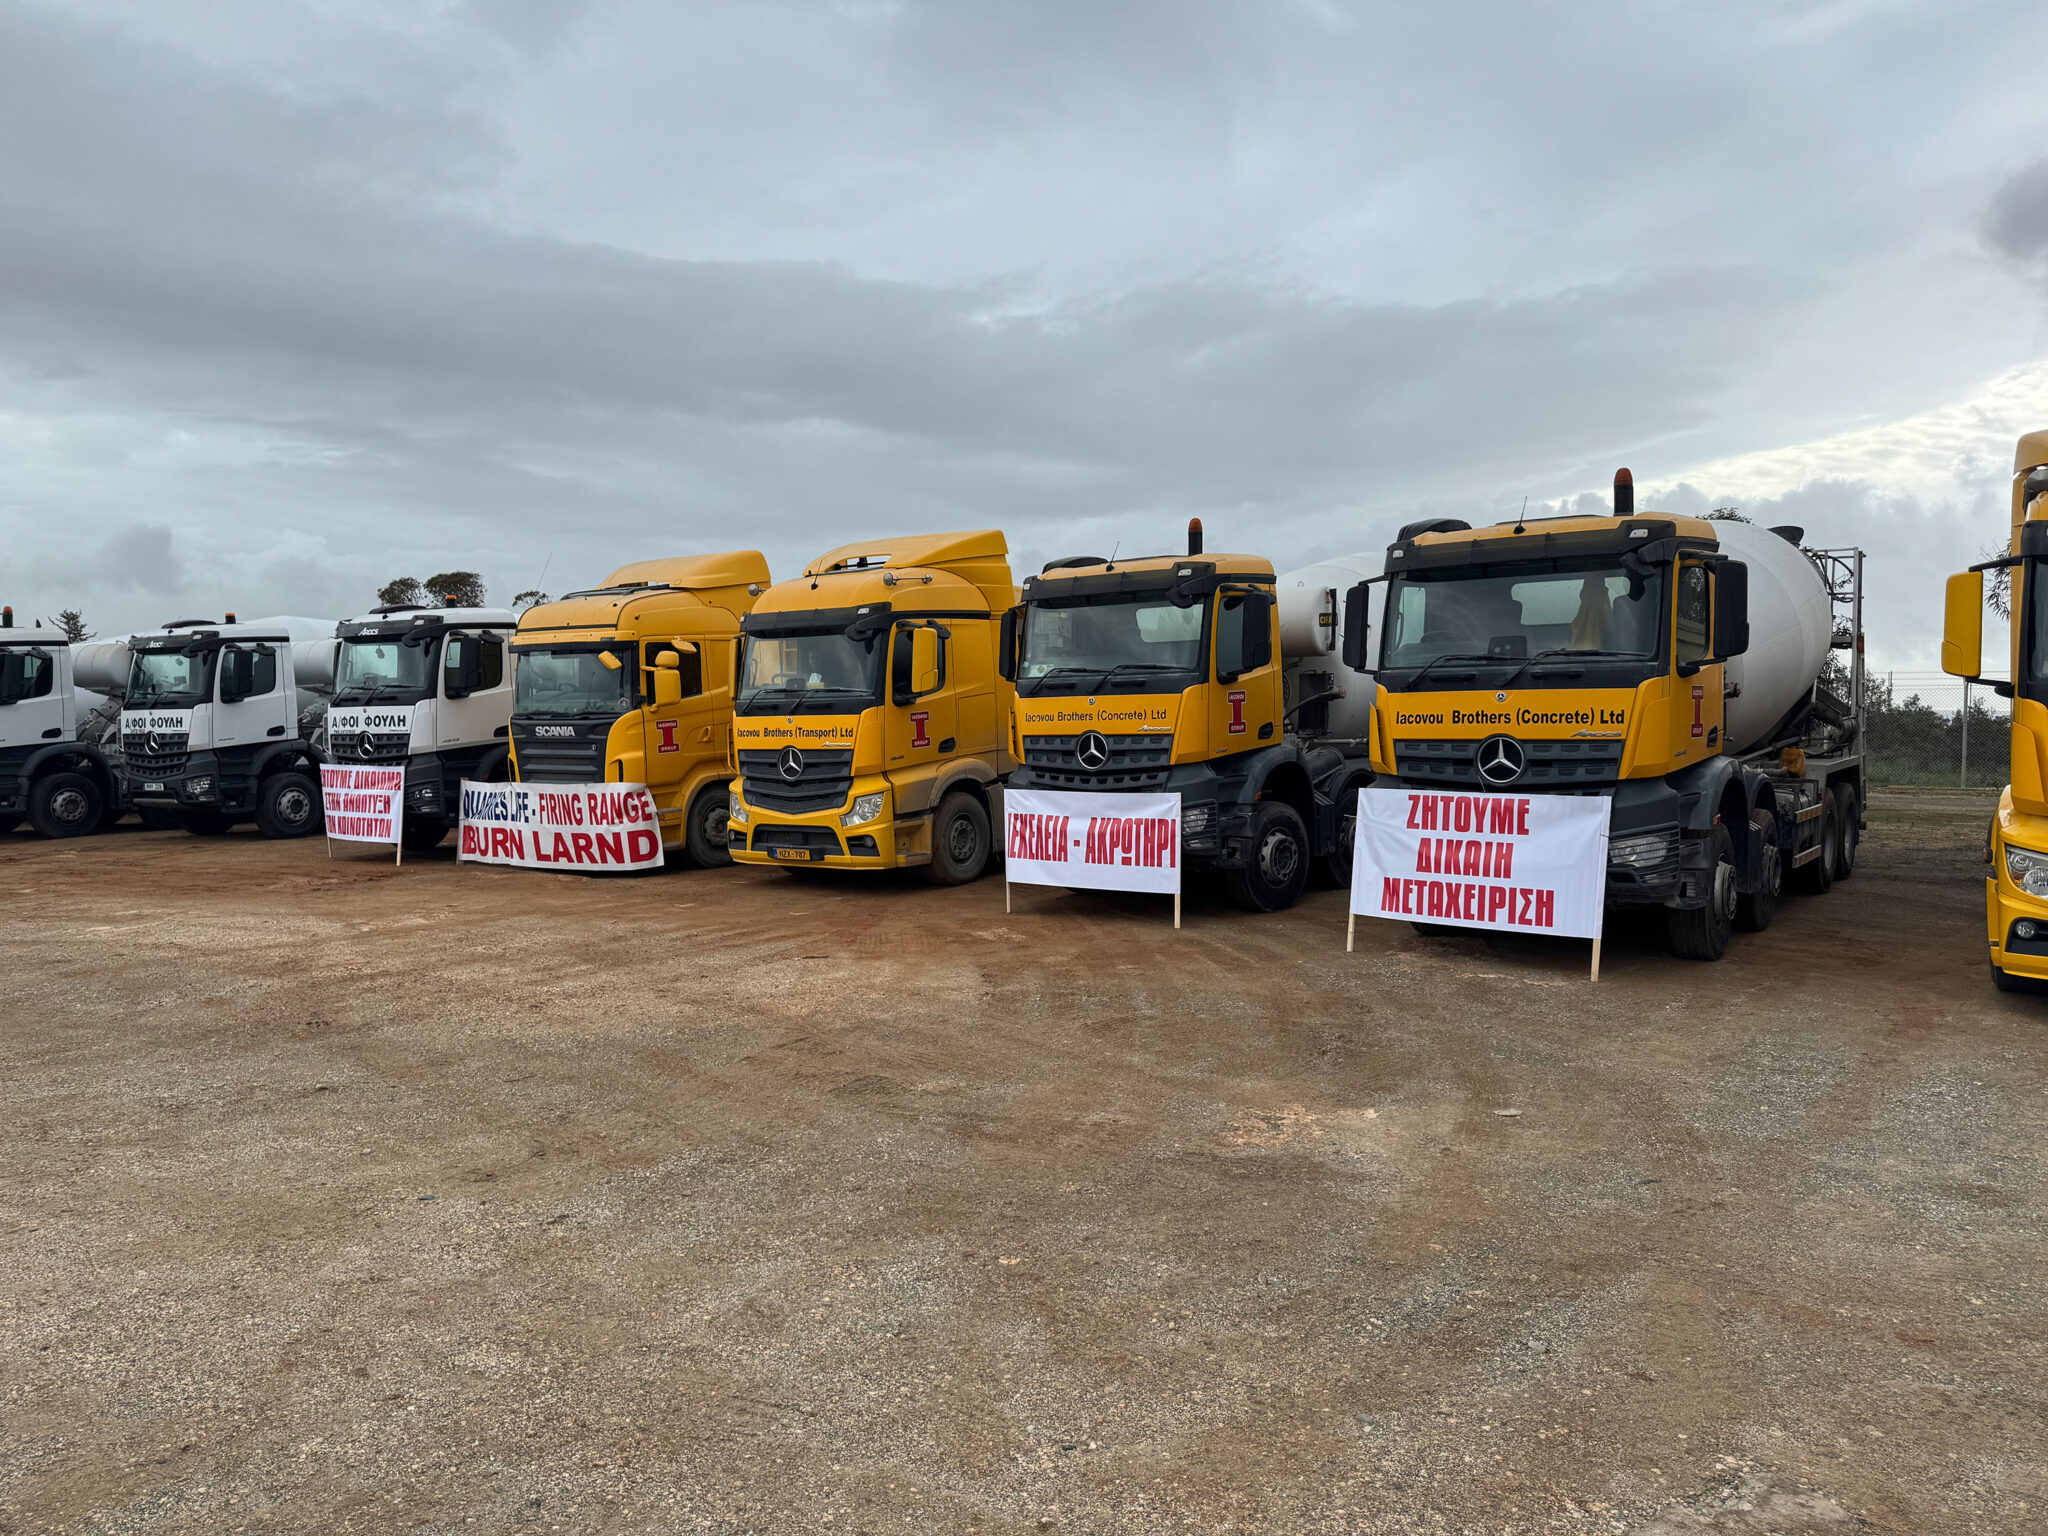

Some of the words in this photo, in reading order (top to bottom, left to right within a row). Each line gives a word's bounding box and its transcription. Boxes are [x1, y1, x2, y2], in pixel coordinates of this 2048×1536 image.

[149, 716, 183, 729] ΦΟΥΛΗ
[364, 713, 407, 728] ΦΟΥΛΗ
[1025, 712, 1055, 723] Iacovou
[1057, 711, 1094, 722] Brothers
[1097, 709, 1147, 722] (Concrete)
[1151, 709, 1167, 720] Ltd
[1396, 711, 1444, 725] Iacovou
[1452, 709, 1511, 725] Brothers
[1516, 707, 1595, 727] (Concrete)
[1600, 709, 1625, 725] Ltd
[535, 725, 576, 737] SCANIA
[736, 728, 760, 738] Iacovou
[763, 727, 793, 738] Brothers
[795, 726, 838, 739] (Transport)
[840, 727, 854, 738] Ltd
[539, 792, 584, 826] FIRING
[587, 790, 653, 826] RANGE
[1406, 794, 1530, 836] ΖΗΤΟΥΜΕ
[462, 824, 525, 860] BURN
[532, 829, 659, 865] LARND
[1085, 816, 1176, 868] ΑΚΡΩΤΗΡΙ
[1415, 837, 1514, 879] ΔΙΚΑΙΗ
[1381, 876, 1555, 928] ΜΕΤΑΧΕΙΡΙΣΗ
